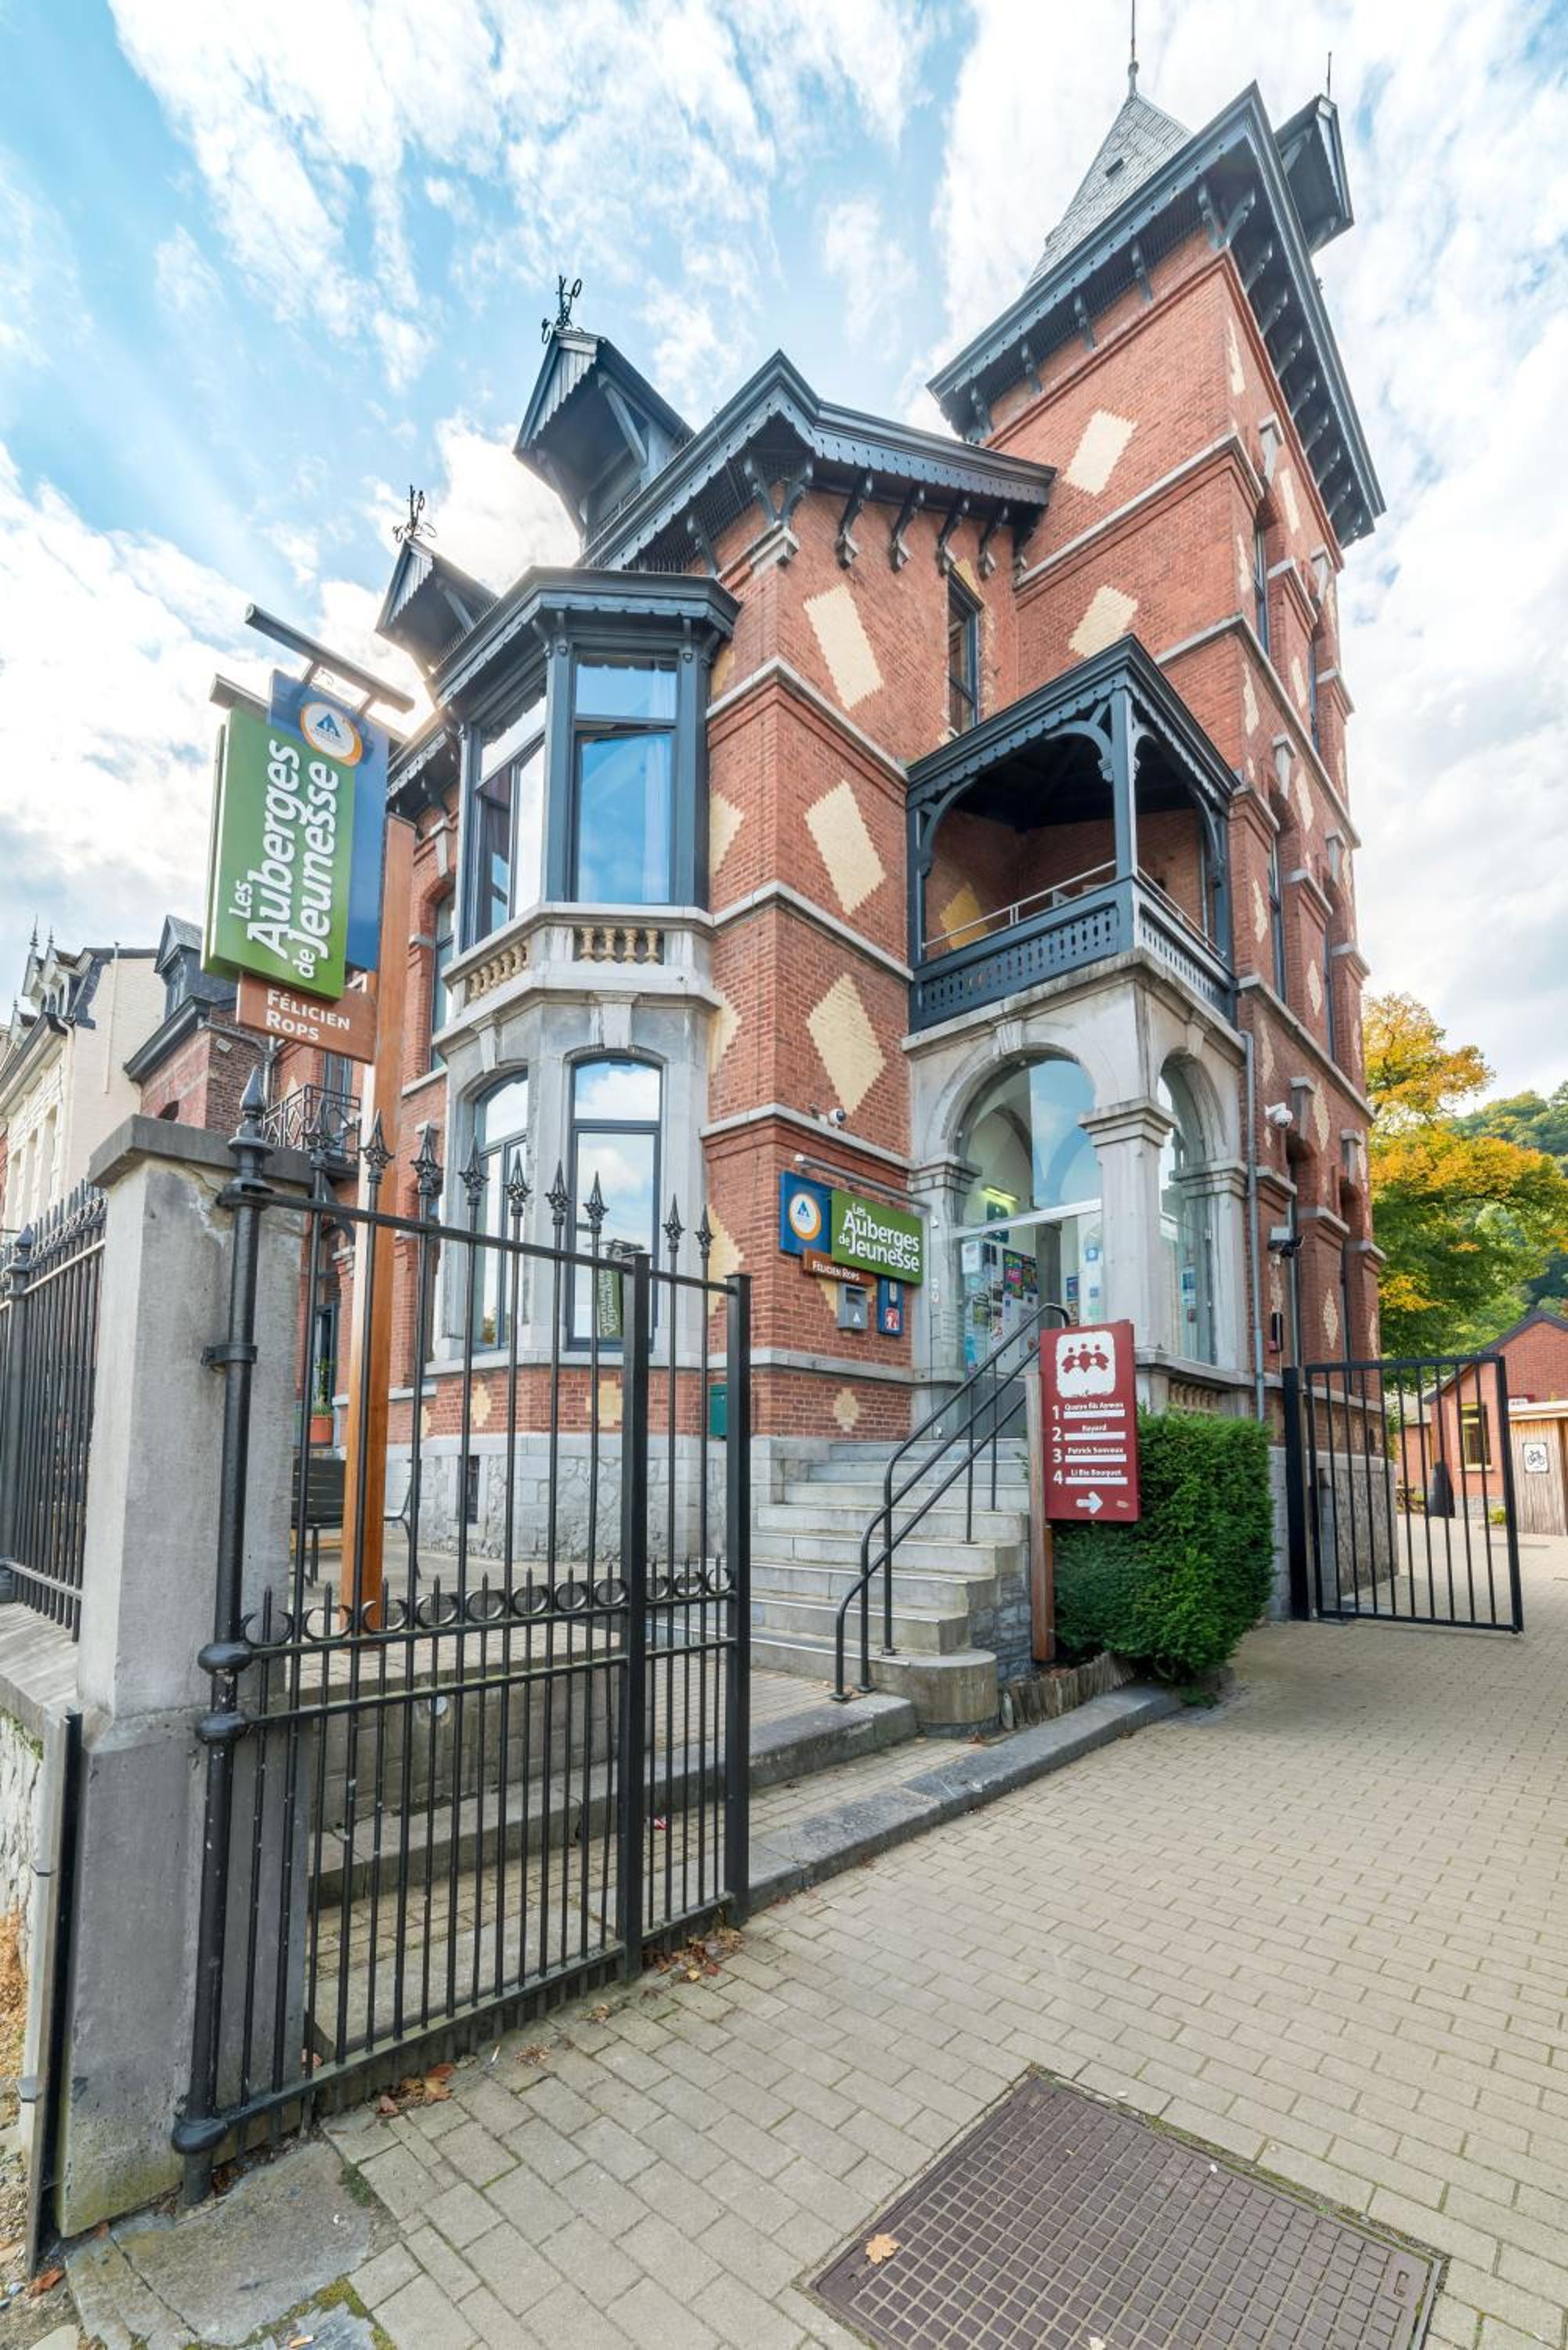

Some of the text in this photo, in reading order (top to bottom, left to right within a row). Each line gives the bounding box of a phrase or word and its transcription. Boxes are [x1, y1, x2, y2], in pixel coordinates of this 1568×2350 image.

[247, 739, 307, 960] Auberges
[287, 761, 339, 960] Jeunesse
[228, 879, 253, 920] Les
[292, 949, 316, 978] de
[266, 1009, 320, 1041] ROPS
[851, 1202, 866, 1217] Les
[842, 1209, 920, 1253] Auberges
[838, 1231, 920, 1273] de Jeunesse
[1052, 1405, 1060, 1420] 1
[1052, 1426, 1062, 1442] 2
[1052, 1448, 1062, 1463] 3
[1052, 1470, 1064, 1485] 4
